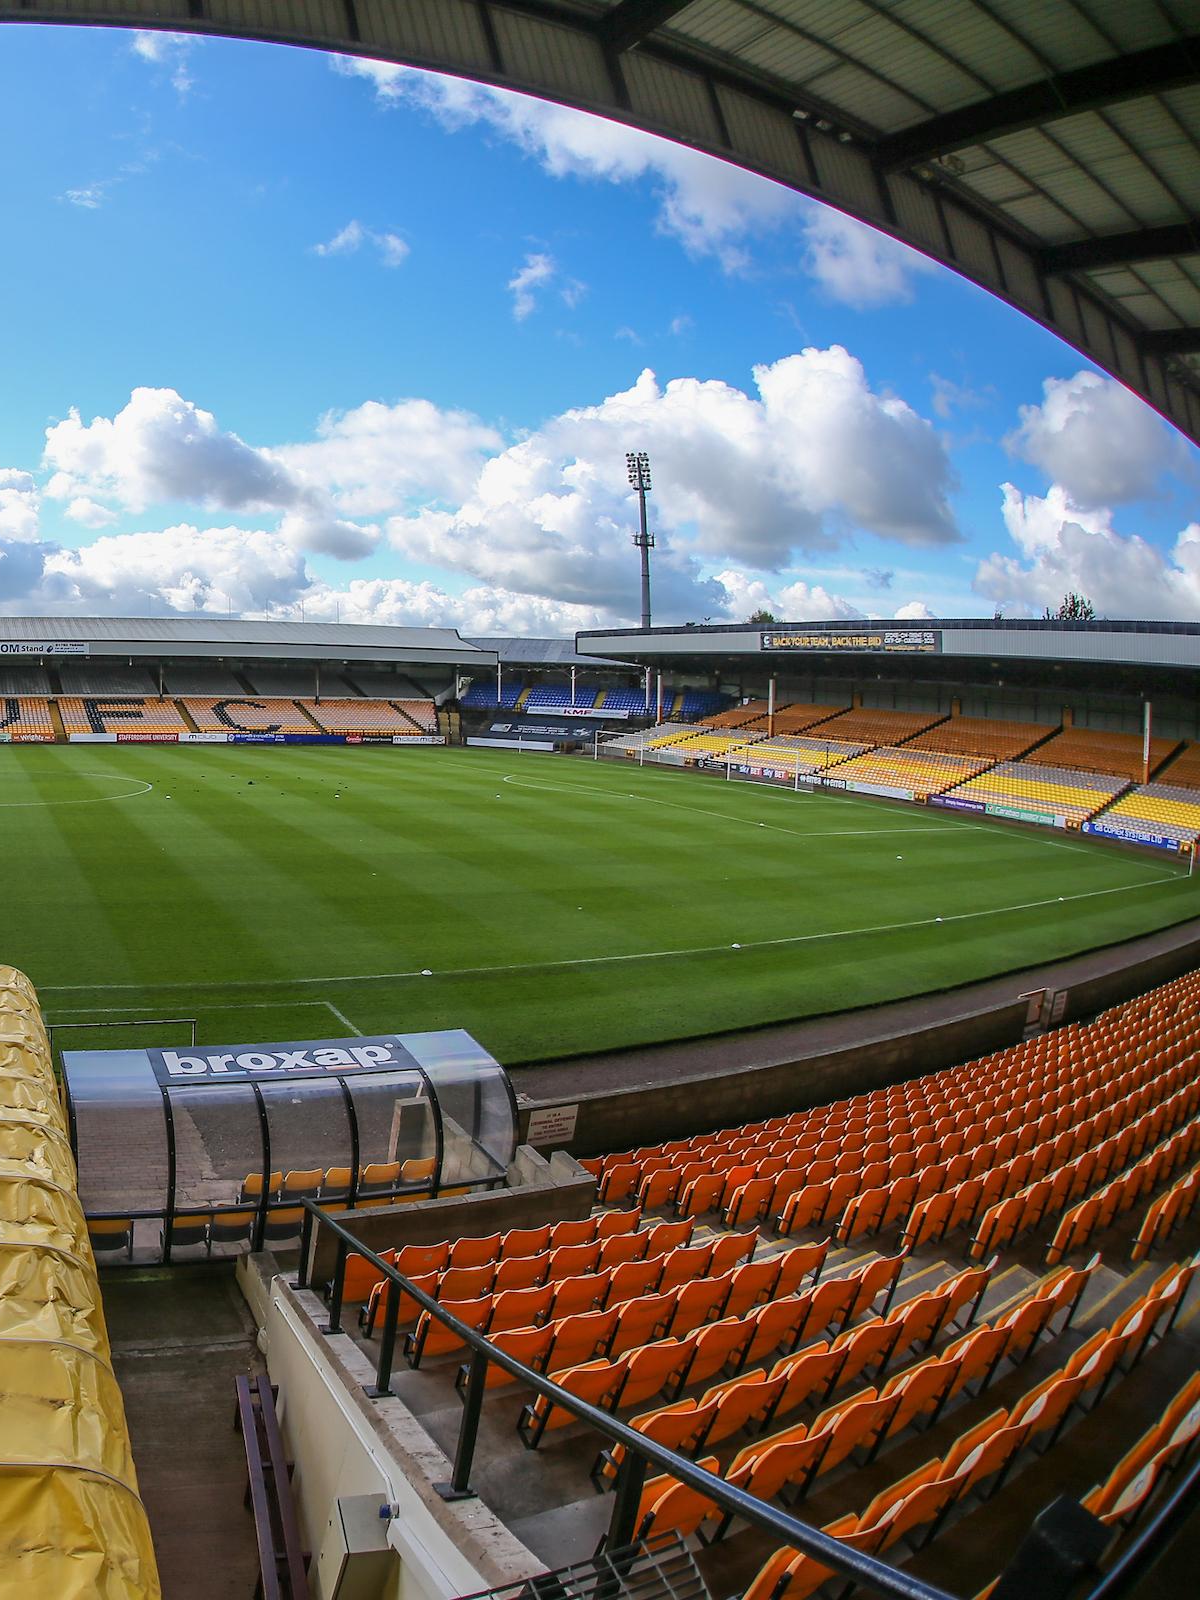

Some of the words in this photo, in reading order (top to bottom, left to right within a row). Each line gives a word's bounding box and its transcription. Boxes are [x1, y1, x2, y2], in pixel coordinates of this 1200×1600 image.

[773, 637, 790, 646] BACK
[790, 637, 808, 646] YOUR
[832, 637, 851, 646] BACK
[852, 637, 867, 645] THE
[868, 637, 881, 645] BID
[740, 765, 749, 774] sky
[751, 767, 762, 776] BET
[763, 769, 773, 778] sky
[775, 770, 786, 779] BET
[1094, 824, 1103, 832] GB
[1104, 826, 1124, 837] COPIER
[1125, 831, 1150, 842] SYSTEMS
[1151, 836, 1162, 844] LTD
[162, 1044, 392, 1074] broxap
